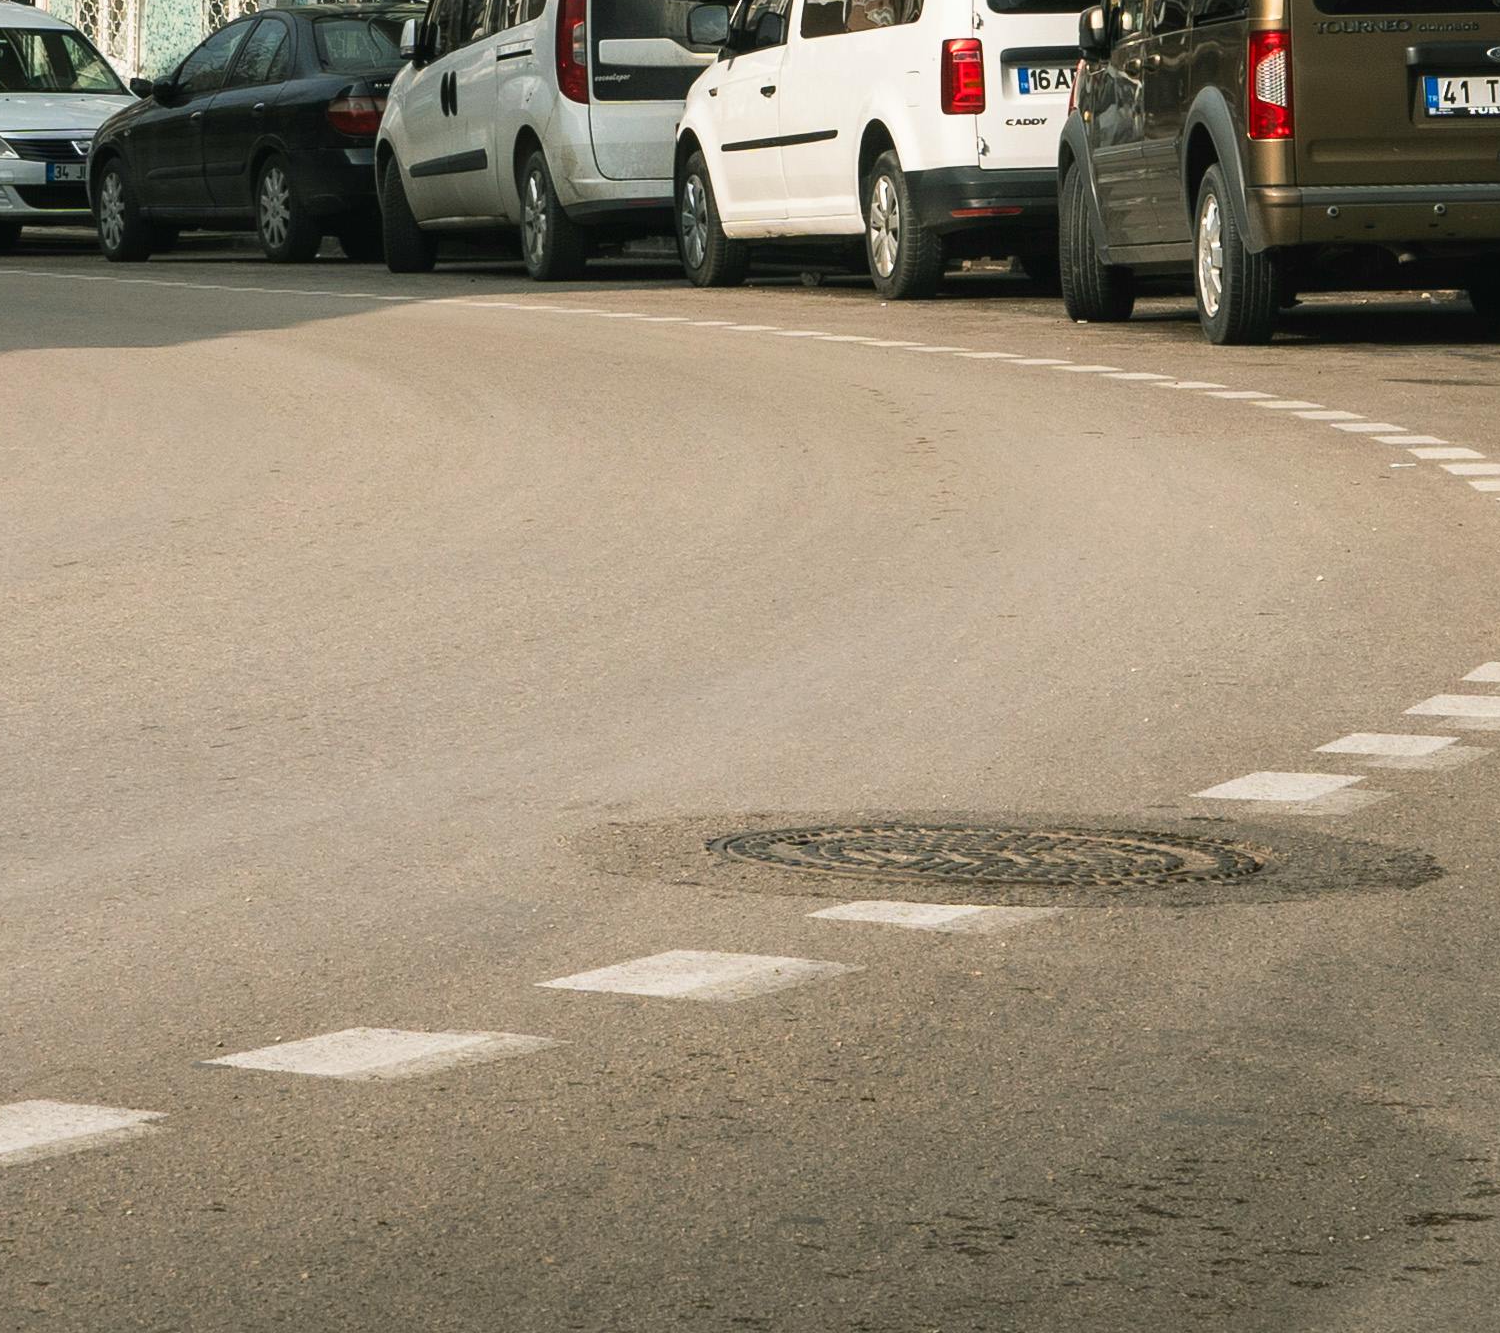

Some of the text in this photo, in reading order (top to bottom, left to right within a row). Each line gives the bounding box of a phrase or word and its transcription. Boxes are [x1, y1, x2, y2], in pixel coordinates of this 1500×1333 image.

[1313, 20, 1411, 34] TOURNEO
[1030, 69, 1051, 90] 16
[1443, 80, 1470, 104] 41
[1005, 118, 1048, 126] CADDY
[54, 165, 69, 180] 34
